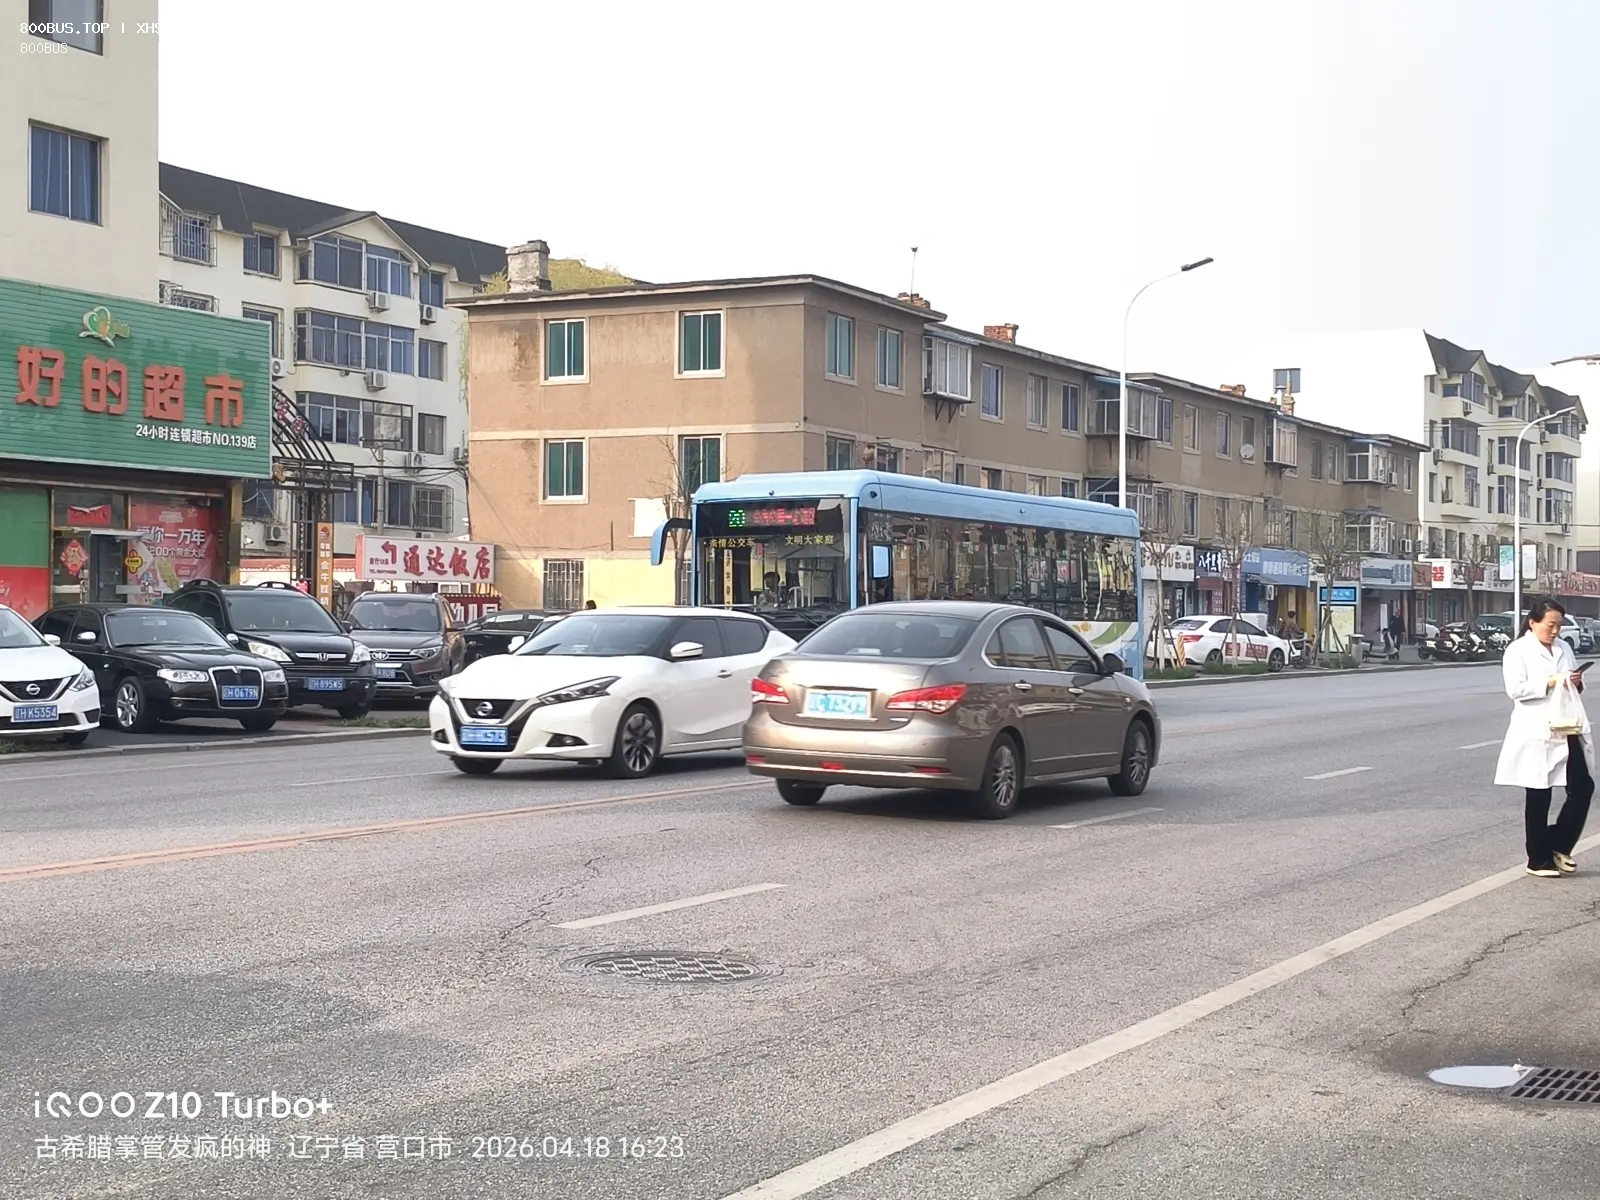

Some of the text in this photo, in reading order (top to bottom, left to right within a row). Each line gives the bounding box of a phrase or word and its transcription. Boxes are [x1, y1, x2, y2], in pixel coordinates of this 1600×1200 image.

[16, 345, 246, 428] 好的超市
[136, 423, 257, 449] 24小时连锁超市NO.139店
[403, 544, 491, 580] 通达饭店
